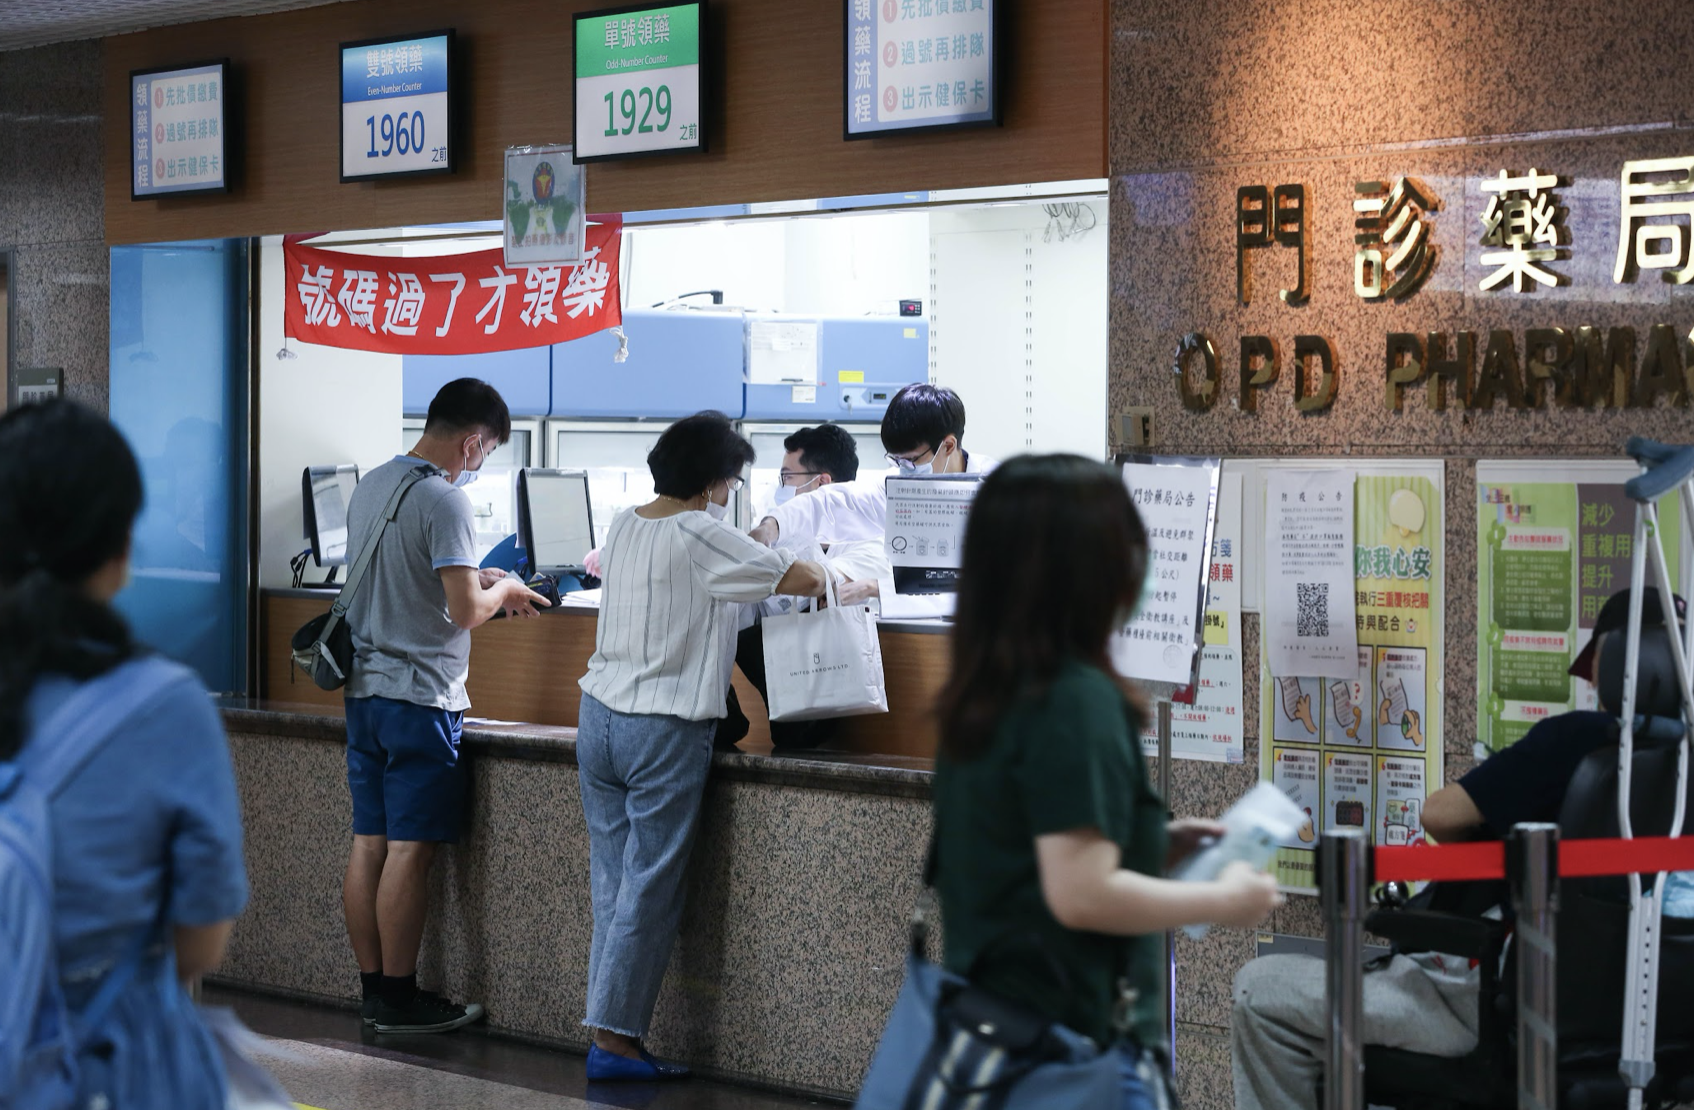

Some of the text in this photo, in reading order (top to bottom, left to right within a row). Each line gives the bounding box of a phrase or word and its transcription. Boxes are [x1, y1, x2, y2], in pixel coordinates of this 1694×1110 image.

[604, 13, 670, 50] 單號領藥
[366, 44, 423, 79] 雙號領藥
[606, 54, 669, 70] Odd-Number Counter
[901, 32, 985, 66] 過號再排隊
[165, 81, 218, 107] 先批價繳費
[367, 82, 422, 97] Even-Number Counter
[902, 78, 985, 110] 出示健保卡
[604, 84, 672, 137] 1929
[136, 83, 149, 188] 領藥流程
[166, 117, 219, 143] 過號再排隊
[366, 110, 425, 158] 1960
[679, 123, 697, 141] 之前
[167, 154, 219, 179] 出示健保卡
[431, 146, 447, 163] 之前
[1236, 156, 1694, 302] 門診藥局
[298, 246, 610, 337] 號碼過了才領藥
[1174, 324, 1694, 413] OPD PHARMA
[1132, 488, 1196, 508] 門診藥局公告
[1281, 490, 1342, 502] 防疫公告
[1581, 502, 1616, 528] 減少
[1581, 533, 1646, 561] 重複用
[1356, 546, 1431, 579] 你我心安
[1581, 564, 1614, 589] 提升
[789, 670, 810, 678] UNITED
[811, 665, 837, 674] ARROWS
